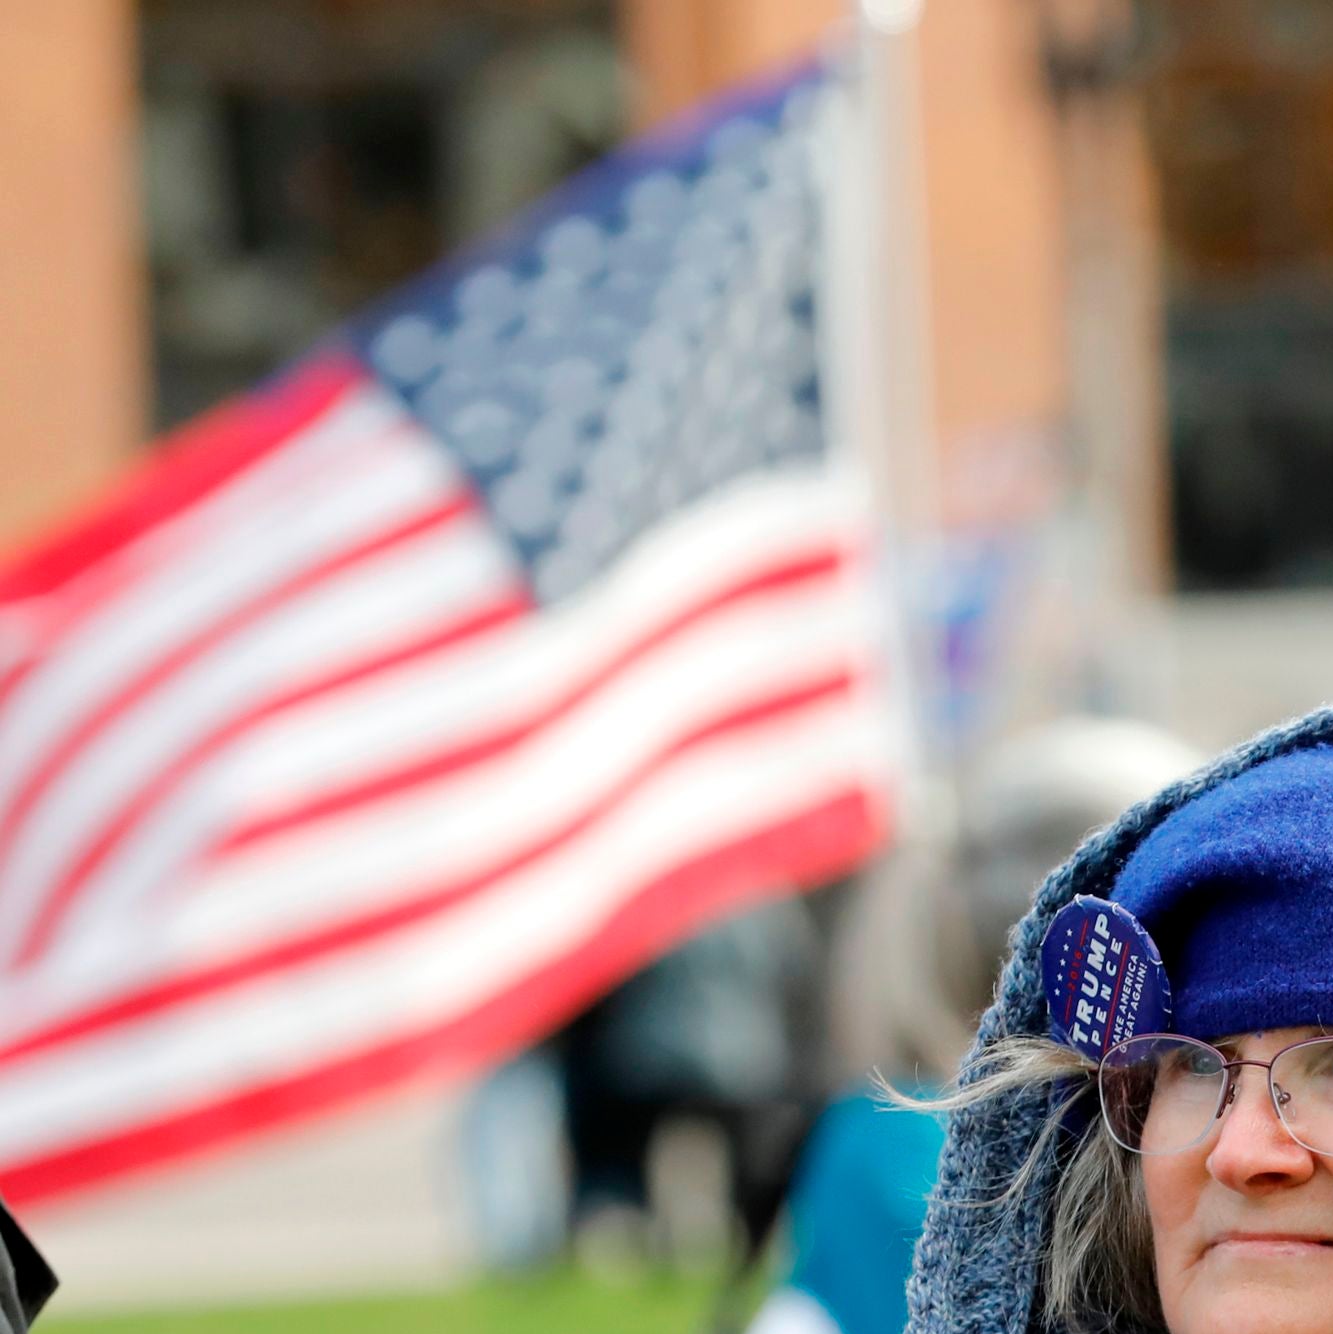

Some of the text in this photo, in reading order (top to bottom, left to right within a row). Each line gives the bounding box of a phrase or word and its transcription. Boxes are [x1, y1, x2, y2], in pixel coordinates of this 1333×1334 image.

[1072, 913, 1111, 1044] TRUMP
[1091, 937, 1123, 1046] PENCE
[1119, 954, 1139, 1014] AMERICA
[1131, 962, 1148, 1011] AGAIN!
